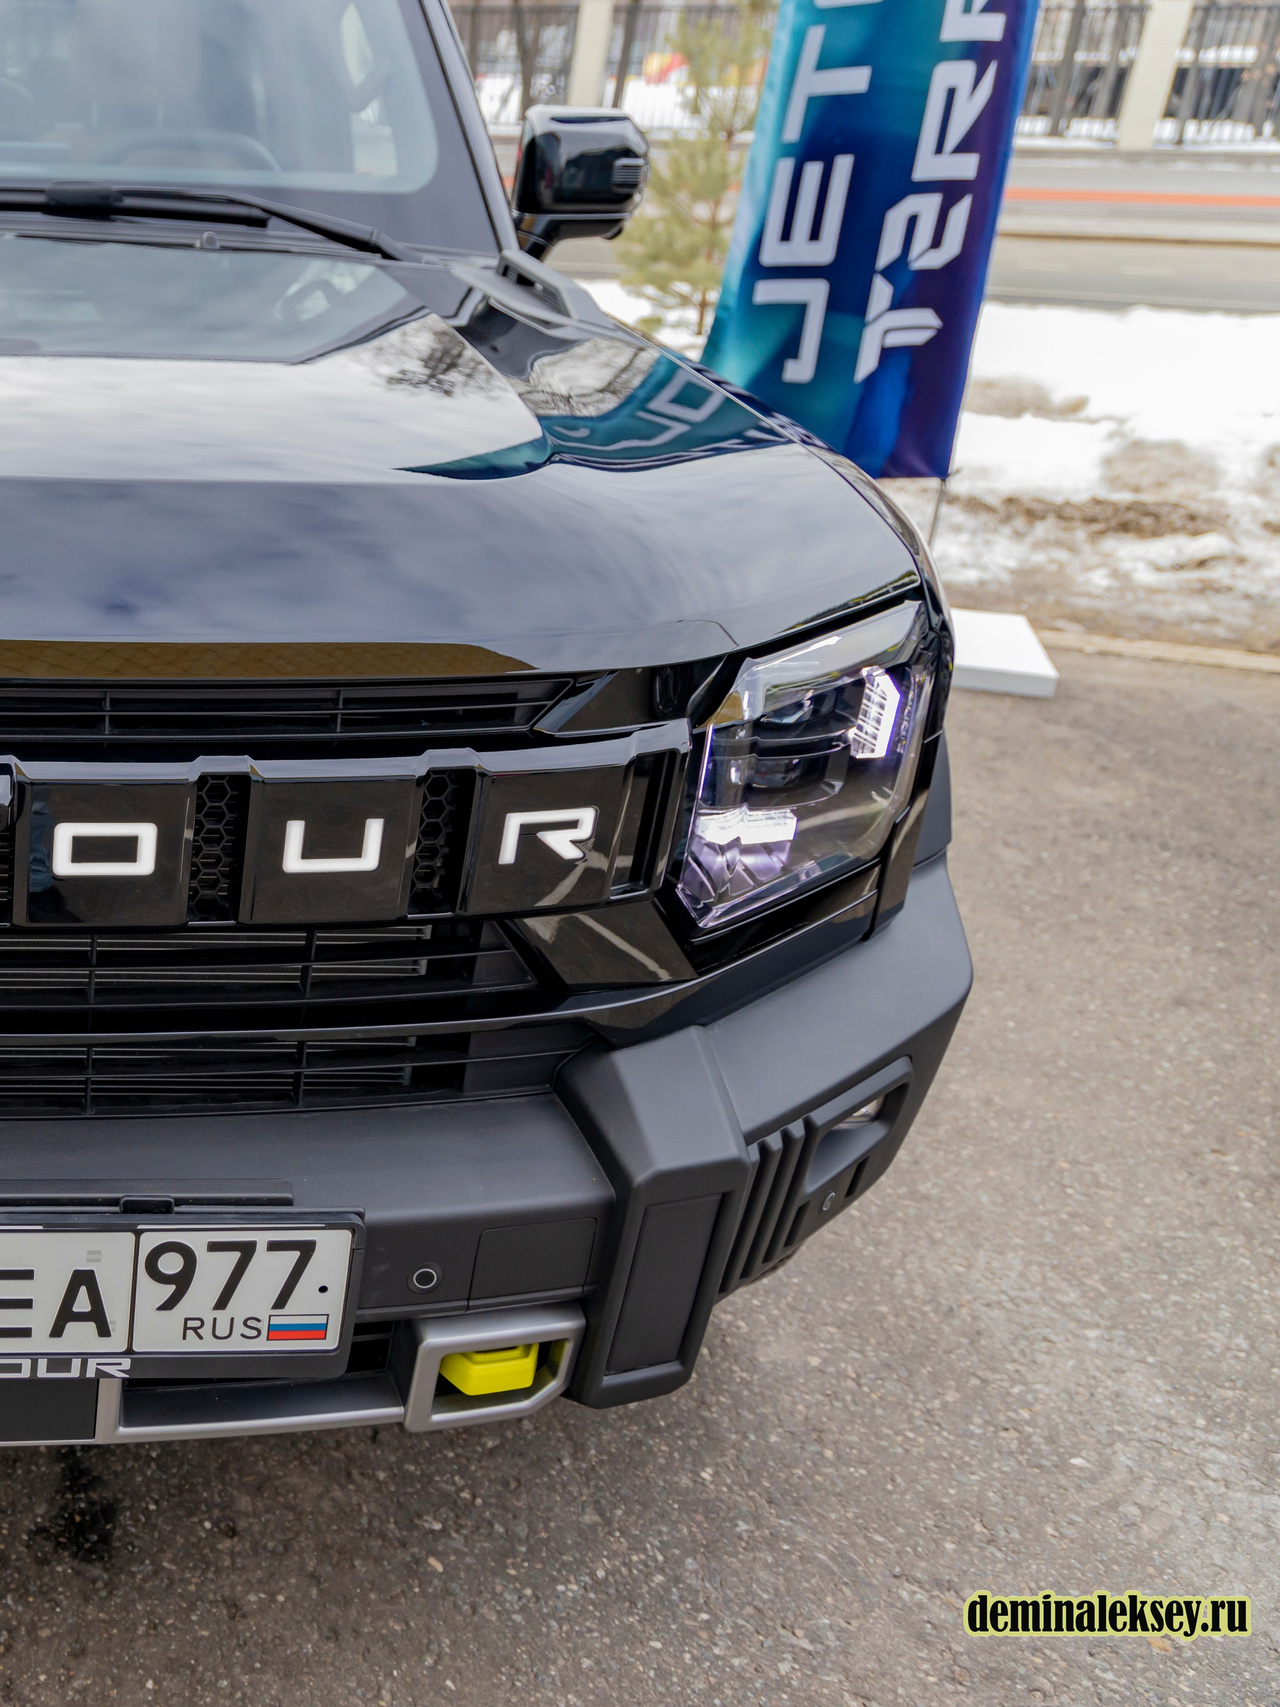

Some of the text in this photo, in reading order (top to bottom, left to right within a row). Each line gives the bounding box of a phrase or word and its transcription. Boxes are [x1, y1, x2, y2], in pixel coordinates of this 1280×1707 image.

[753, 0, 872, 384] JET
[143, 1239, 318, 1312] 977
[181, 1316, 263, 1341] RUS
